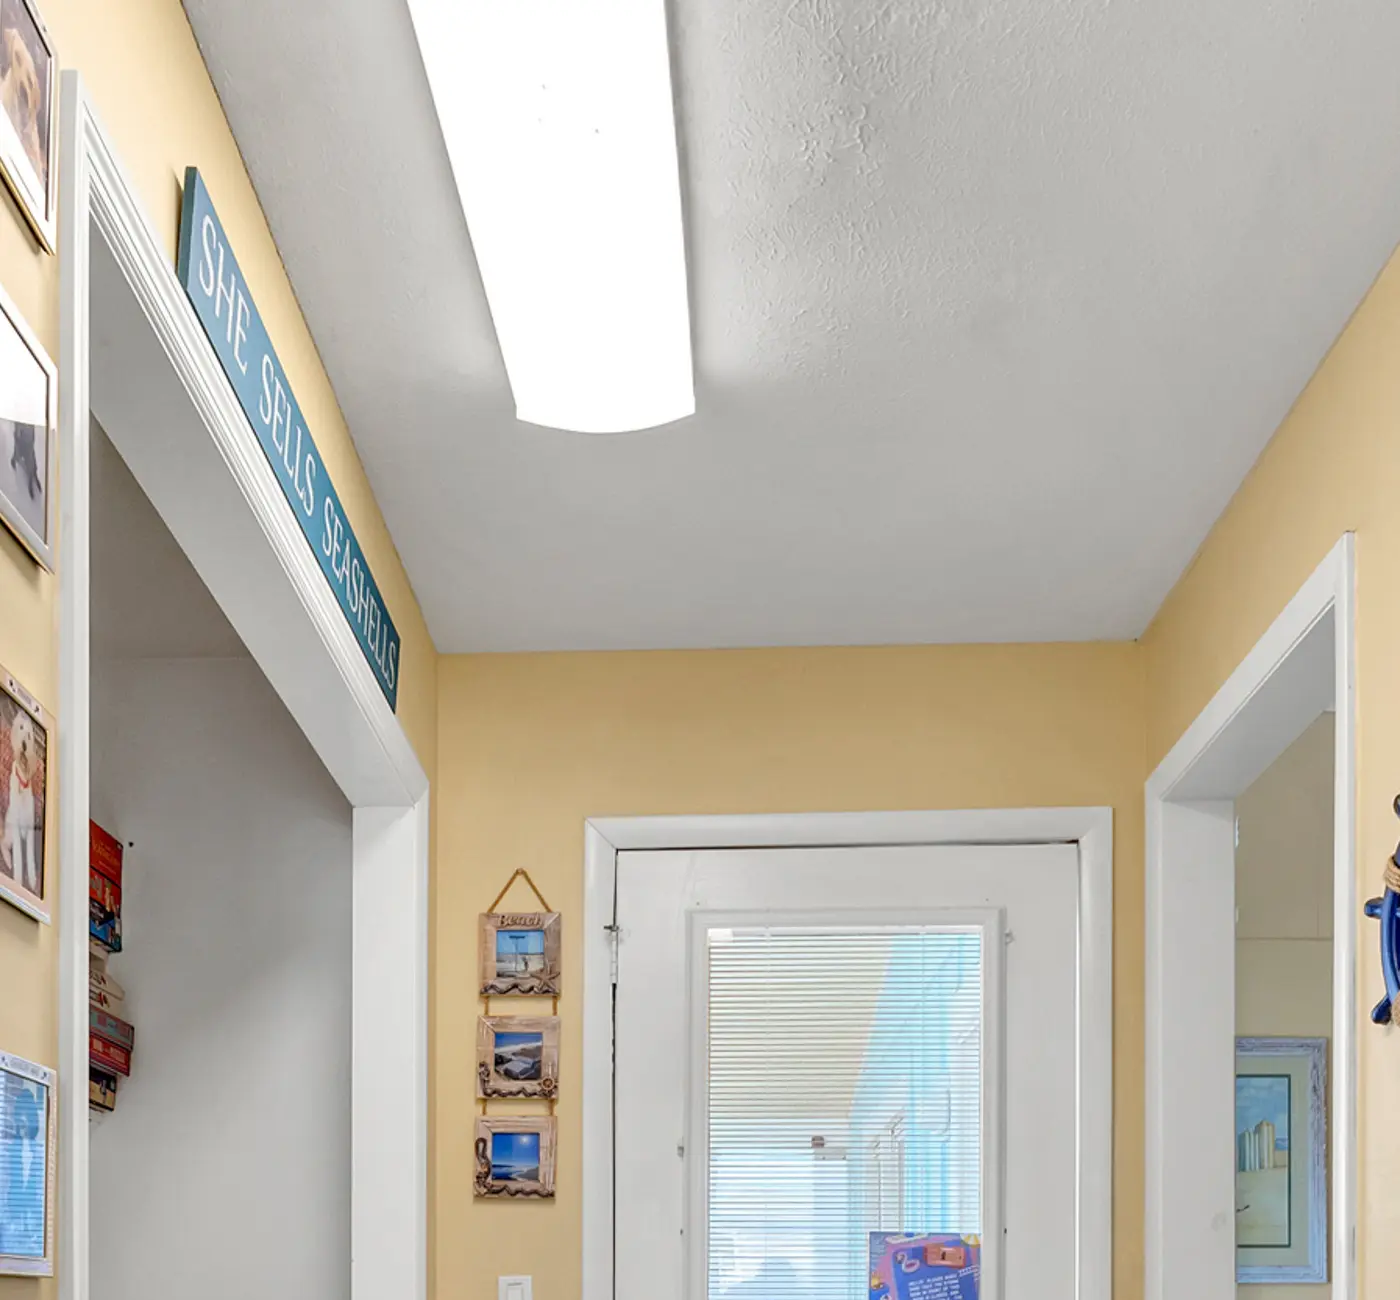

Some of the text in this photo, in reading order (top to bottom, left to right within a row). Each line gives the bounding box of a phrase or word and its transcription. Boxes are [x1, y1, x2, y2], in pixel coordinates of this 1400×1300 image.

[198, 214, 398, 692] SHE SELLS SEASHELLS
[498, 912, 543, 927] Beach
